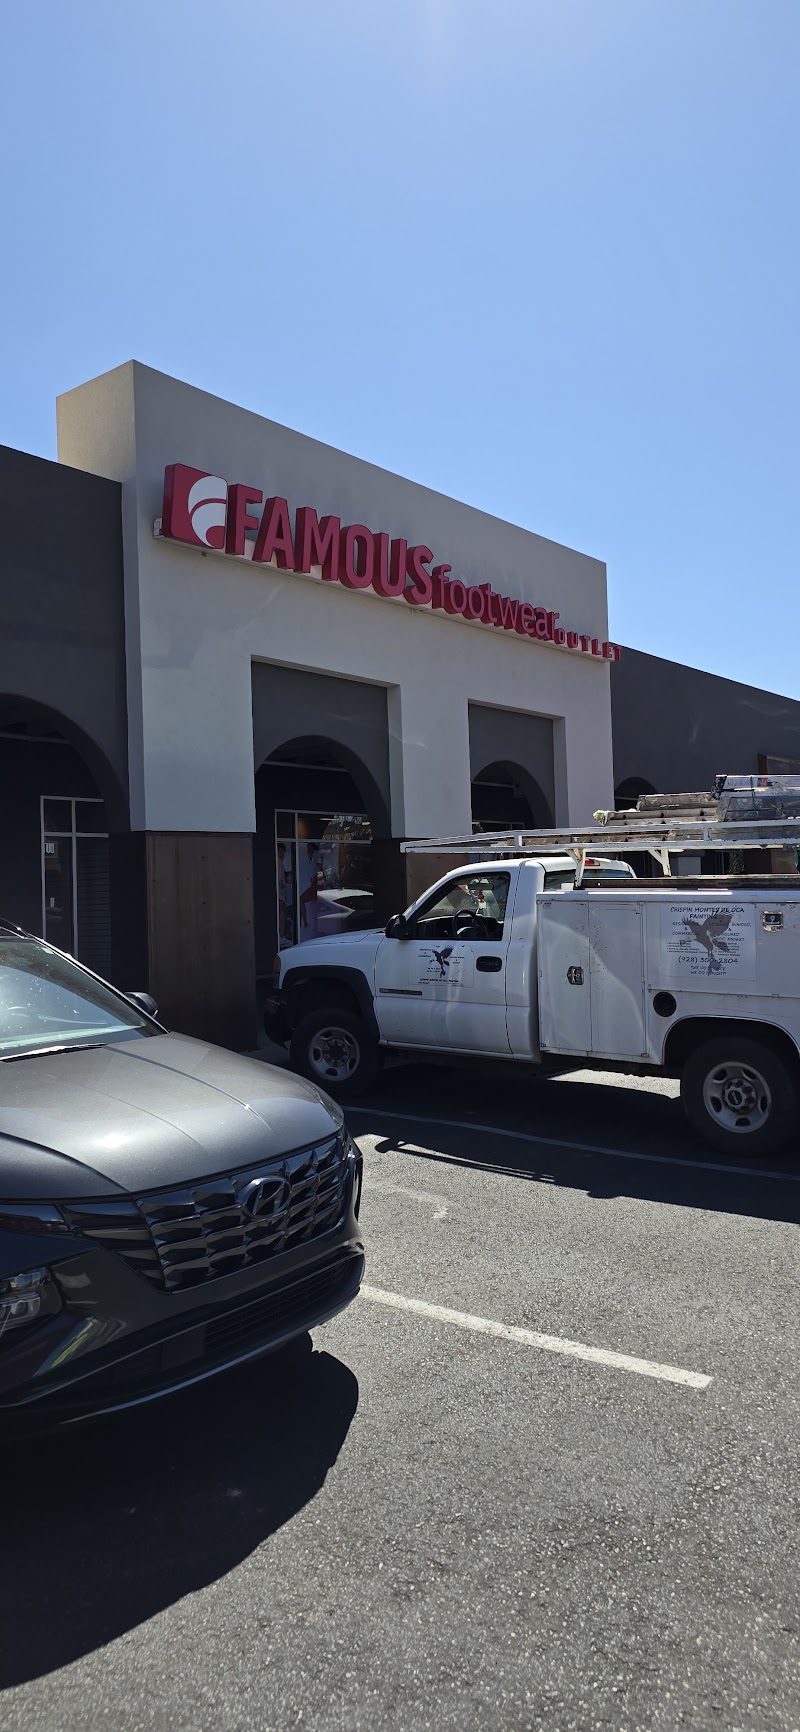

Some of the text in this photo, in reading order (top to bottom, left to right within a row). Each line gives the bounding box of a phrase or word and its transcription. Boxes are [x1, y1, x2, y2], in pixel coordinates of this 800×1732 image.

[225, 483, 623, 661] FAMOUS footwear OUTLET
[678, 955, 698, 964] (928)
